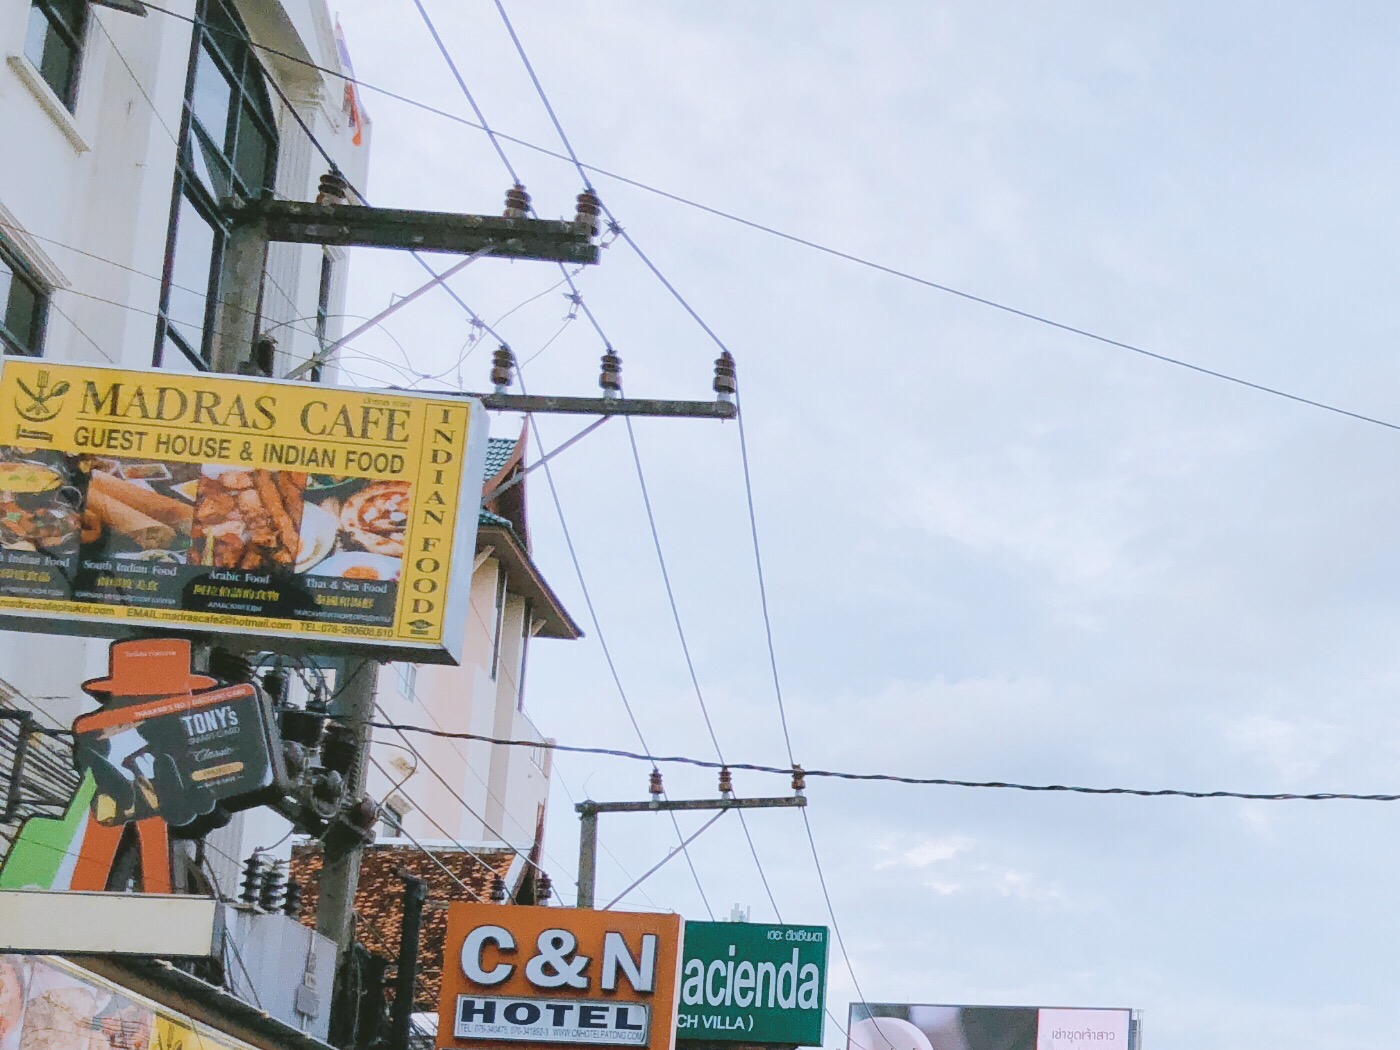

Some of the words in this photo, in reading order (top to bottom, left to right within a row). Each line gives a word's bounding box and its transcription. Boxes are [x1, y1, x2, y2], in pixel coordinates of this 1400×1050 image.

[77, 379, 277, 431] MADRAS
[301, 401, 410, 444] CAFE
[73, 426, 147, 452] GUEST
[155, 432, 231, 460] HOUSE
[239, 441, 253, 462] &
[263, 443, 336, 468] INDIAN
[345, 450, 405, 474] FOOD
[422, 408, 454, 527] INDIAN
[83, 559, 112, 571] South
[116, 562, 148, 574] Indian
[152, 566, 177, 577] Food
[209, 569, 240, 582] Arabic
[245, 573, 270, 584] Food
[305, 577, 326, 589] Thai
[363, 582, 388, 594] Food
[410, 537, 441, 614] FOOD
[678, 944, 820, 1010] acienda
[461, 1000, 643, 1031] HOTEL
[702, 1016, 745, 1030] VILLA
